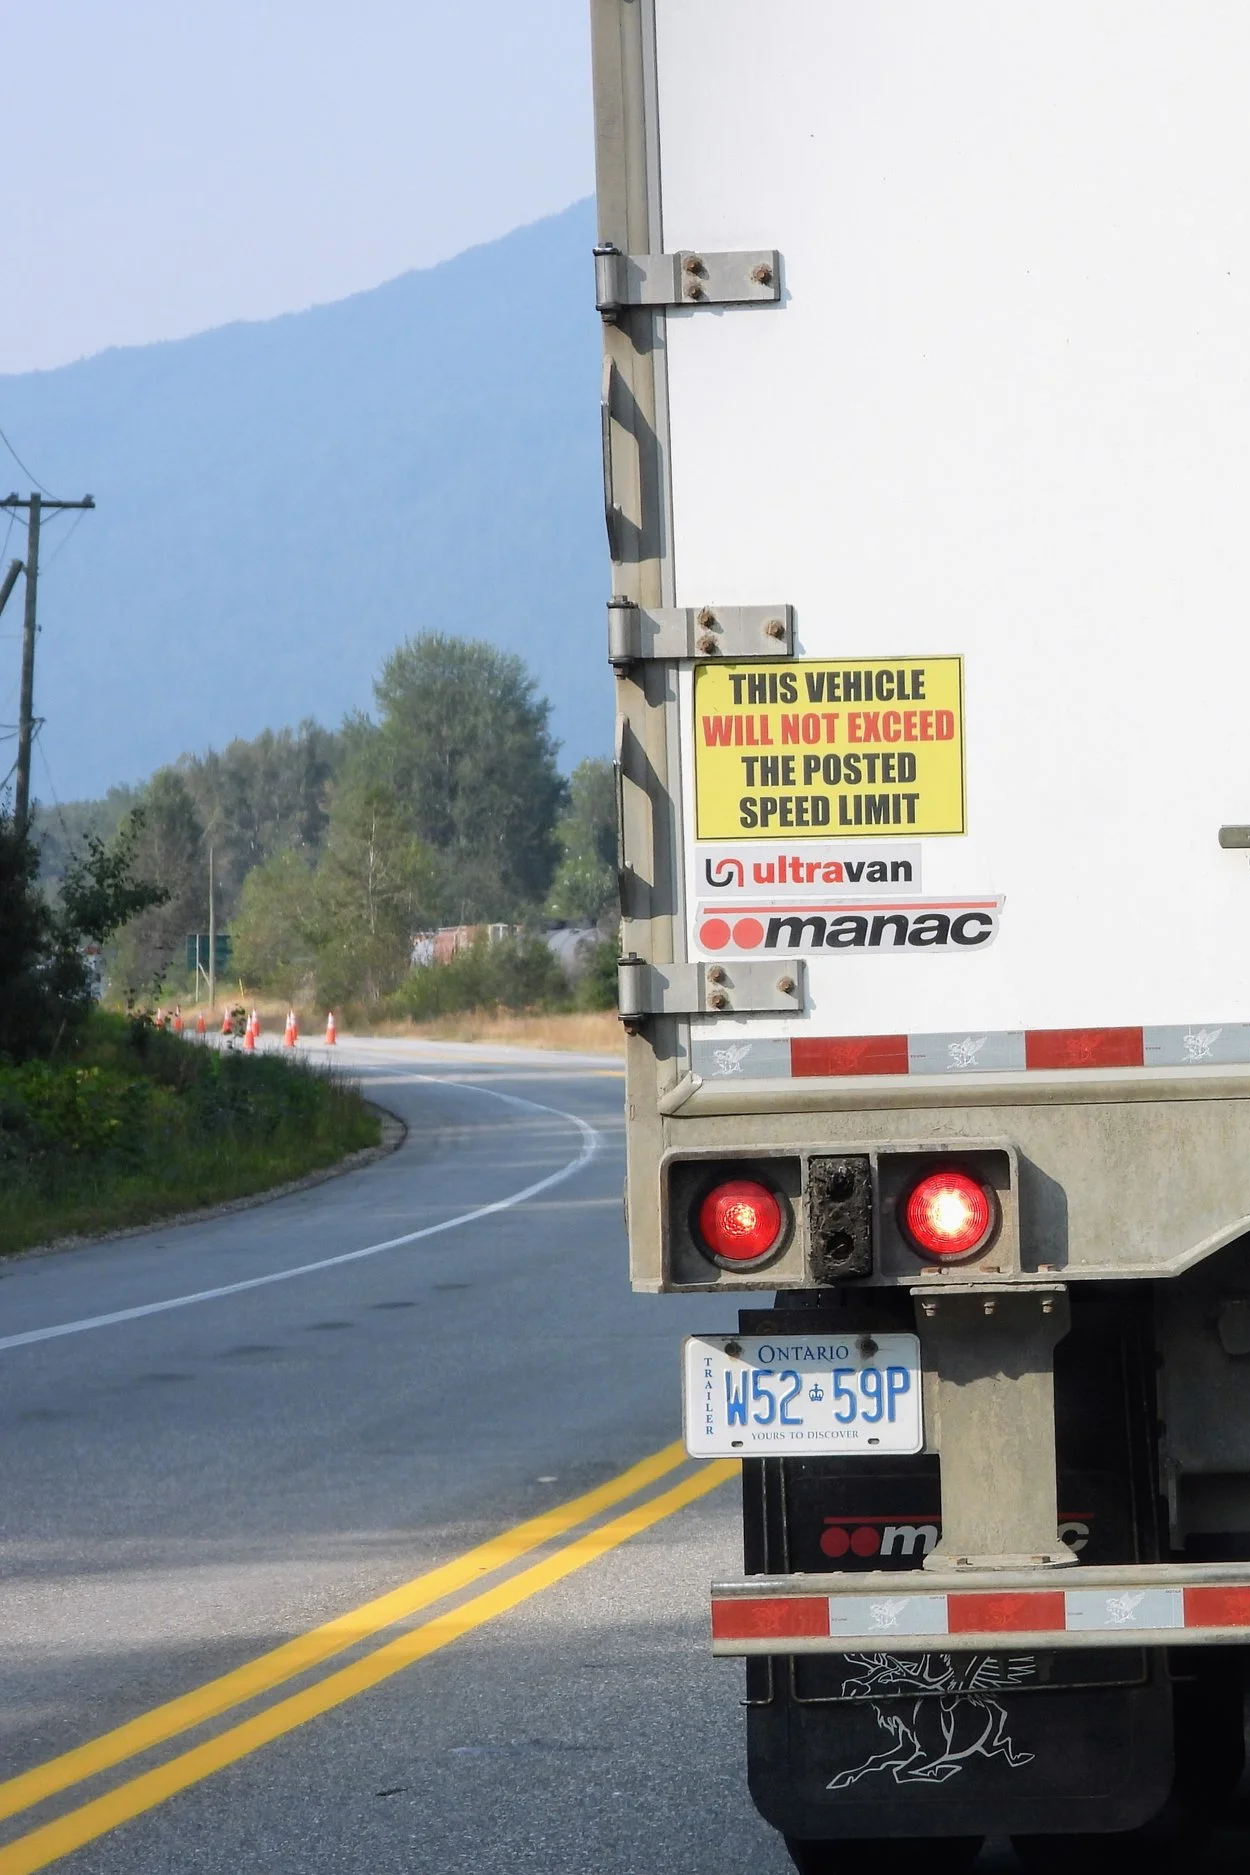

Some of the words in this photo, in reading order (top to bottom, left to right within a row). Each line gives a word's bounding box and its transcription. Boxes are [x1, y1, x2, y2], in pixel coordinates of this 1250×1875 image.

[728, 673, 798, 705] THIS
[805, 669, 926, 703] VEHICLE
[702, 714, 773, 747] WILL
[781, 712, 840, 745] NOT
[847, 710, 955, 744] EXCEED
[741, 755, 797, 787] THE
[803, 752, 917, 786] POSTED
[739, 795, 831, 829] SPEED
[838, 793, 920, 826] LIMIT
[753, 856, 913, 885] ultravan
[764, 912, 993, 948] manac
[703, 1357, 714, 1436] TRAILER
[724, 1367, 803, 1427] W52
[832, 1366, 911, 1424] 59P
[751, 1431, 786, 1441] YOURS
[789, 1430, 805, 1440] TO
[806, 1429, 859, 1440] DISCOVER
